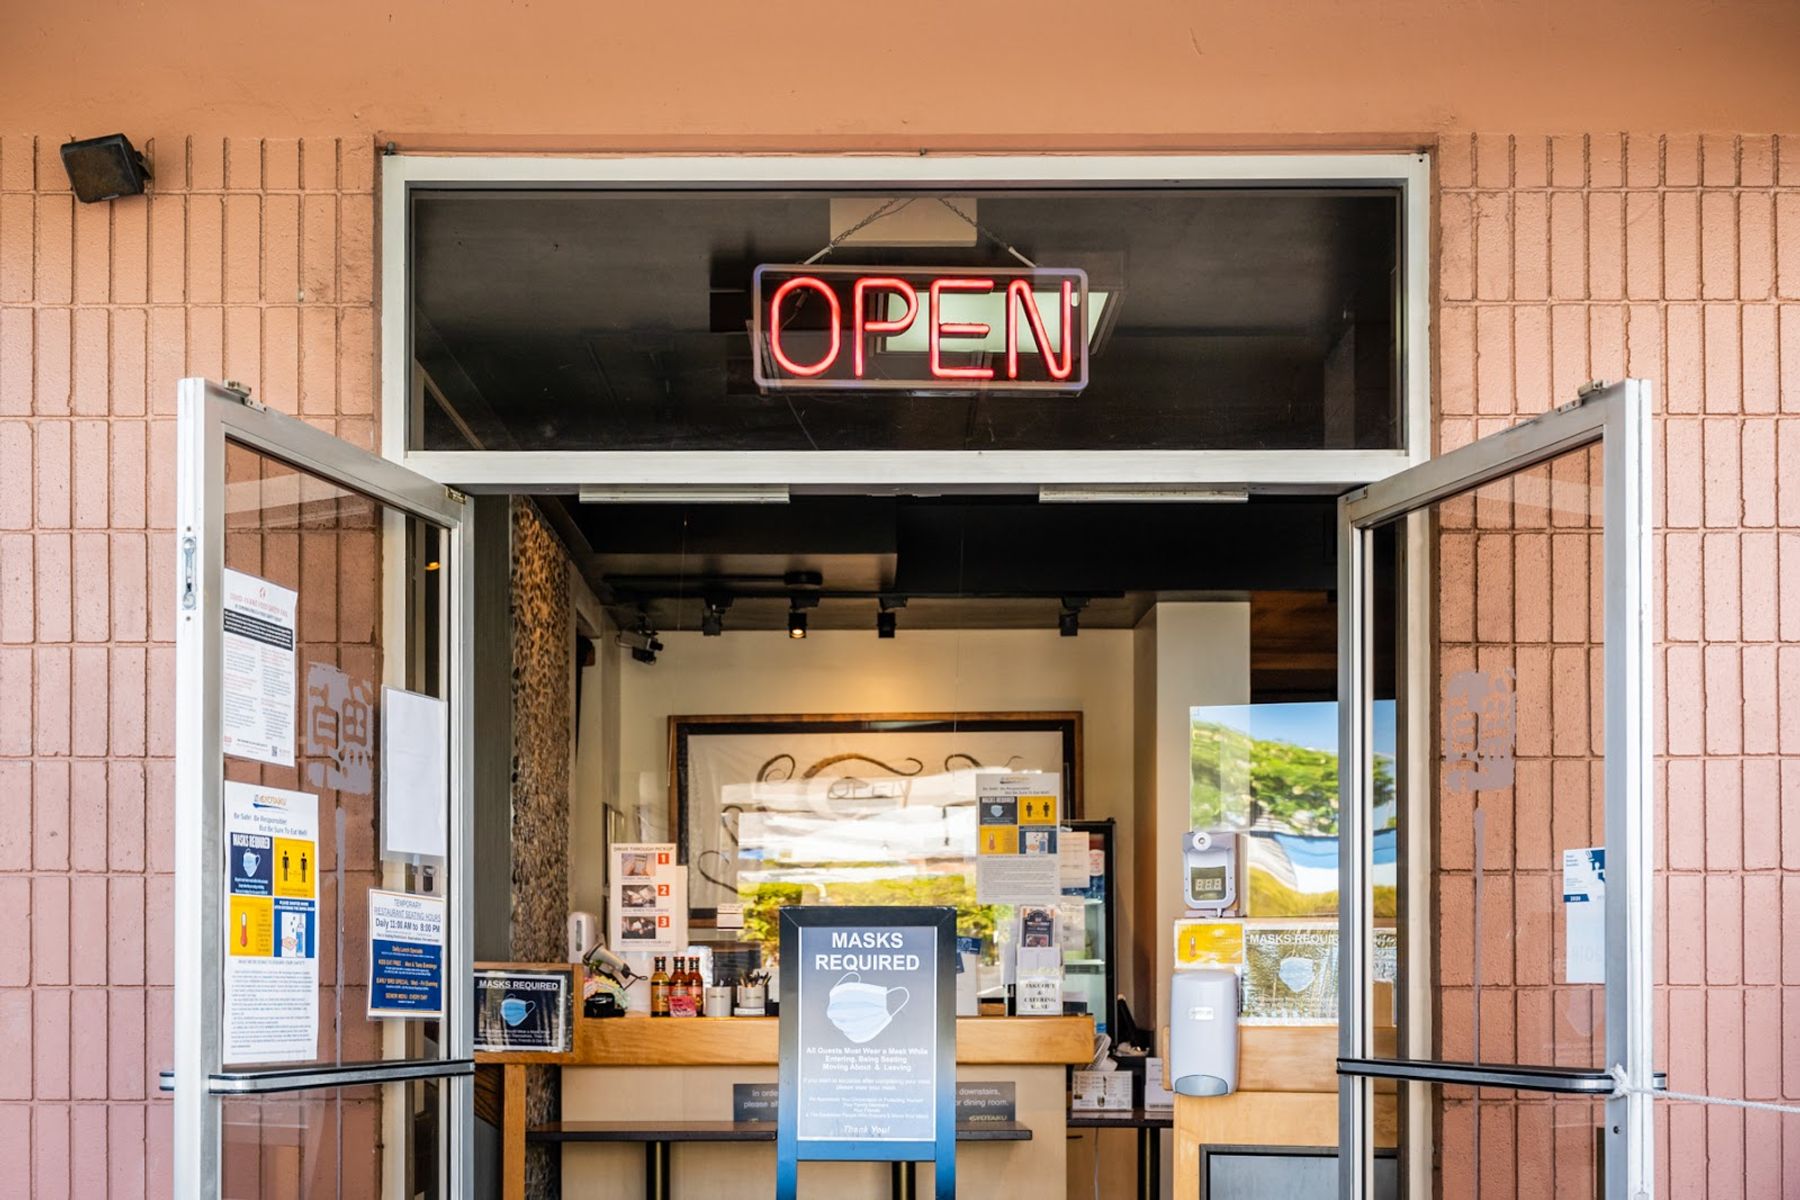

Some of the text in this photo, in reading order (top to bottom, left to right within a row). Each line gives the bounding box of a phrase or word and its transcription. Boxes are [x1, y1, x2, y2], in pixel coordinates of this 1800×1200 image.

[770, 276, 1073, 378] OPEN
[660, 885, 667, 895] 2
[374, 906, 441, 922] RESTAURANT SEATING HOURS
[376, 918, 389, 929] Daily
[404, 921, 412, 929] AM
[413, 923, 418, 931] to
[432, 924, 440, 933] PM
[660, 916, 667, 927] 3
[832, 932, 904, 949] MASKS
[1250, 933, 1291, 944] MASKS
[815, 954, 920, 971] REQUIRED
[479, 979, 559, 991] MASKS REQUIRED
[817, 1047, 842, 1055] Guests
[844, 1047, 860, 1055] Must
[862, 1047, 881, 1055] Wear
[888, 1047, 907, 1055] Mask
[908, 1047, 928, 1055] While
[825, 1055, 908, 1064] Entering, Being Seating
[822, 1063, 848, 1072] Moving
[849, 1063, 870, 1071] About
[884, 1064, 911, 1072] Leaving
[959, 1088, 1001, 1096] downstairs,
[743, 1101, 769, 1109] please
[963, 1099, 986, 1108] dining
[843, 1125, 891, 1134] Thank You!
